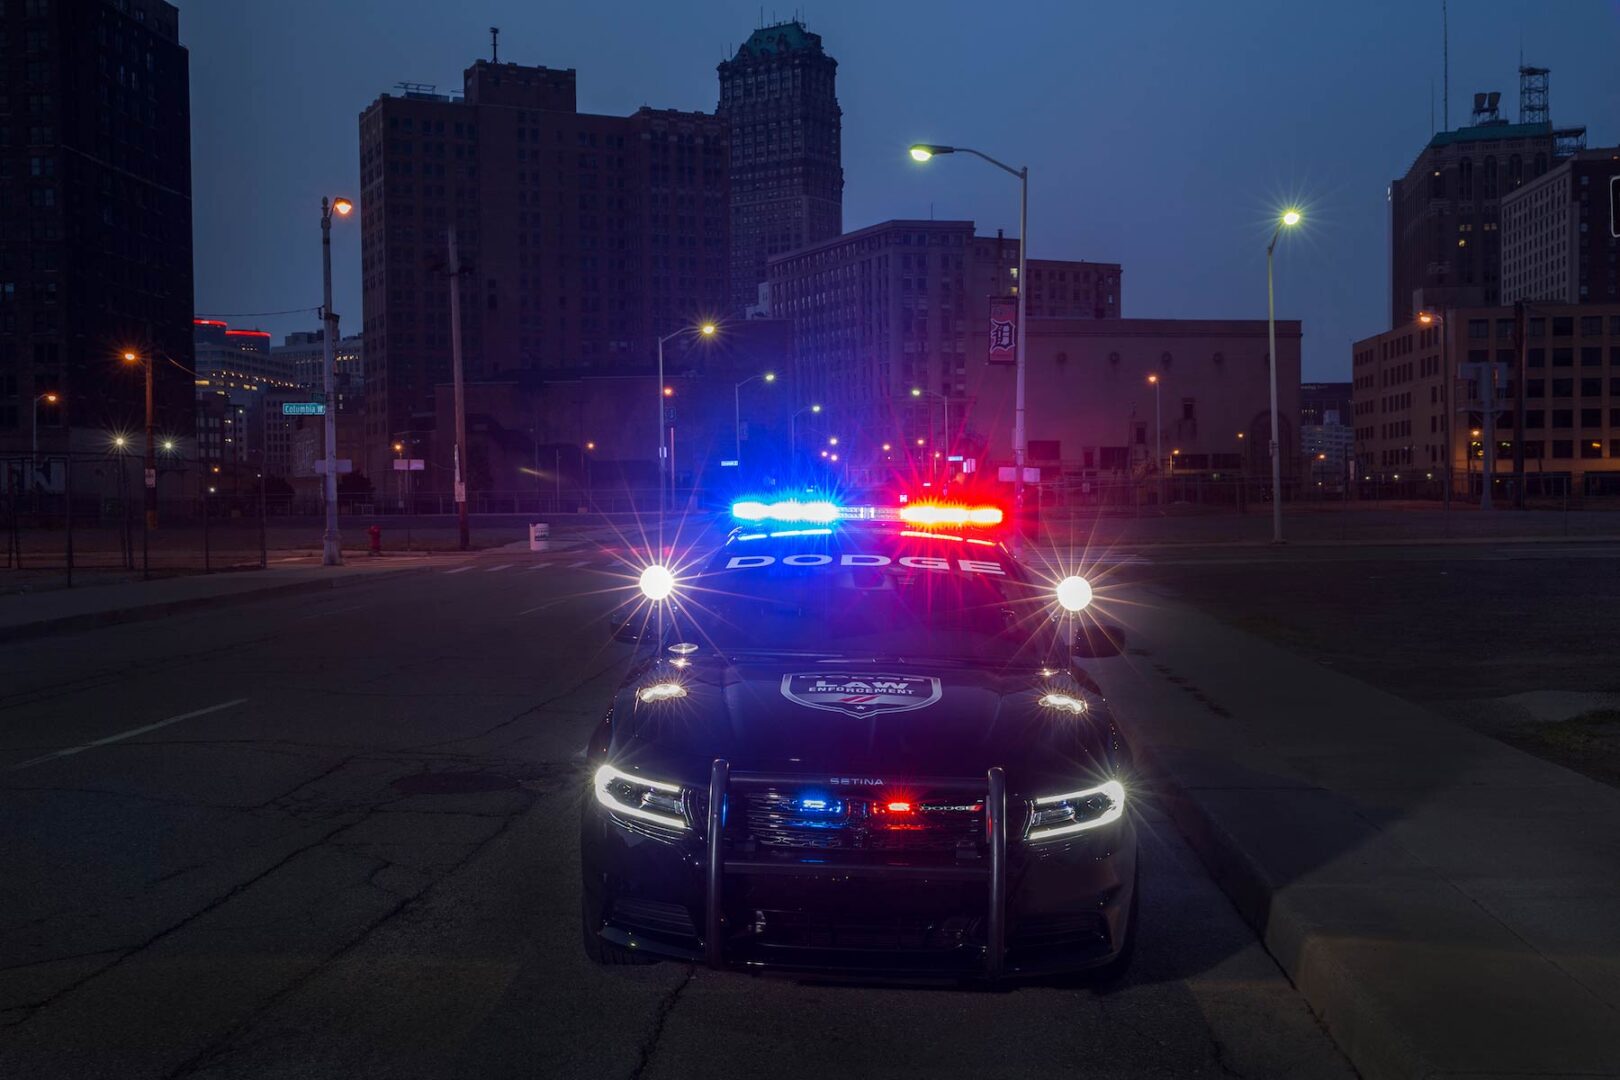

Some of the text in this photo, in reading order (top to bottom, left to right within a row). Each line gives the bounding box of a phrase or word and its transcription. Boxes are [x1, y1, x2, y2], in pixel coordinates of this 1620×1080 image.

[990, 318, 1016, 354] D
[285, 404, 316, 413] Columbia
[725, 553, 1006, 575] DODGE
[816, 680, 909, 690] LAW
[808, 686, 915, 695] ENFORCEMENT
[829, 777, 884, 786] SETINA
[920, 804, 976, 812] DODGE
